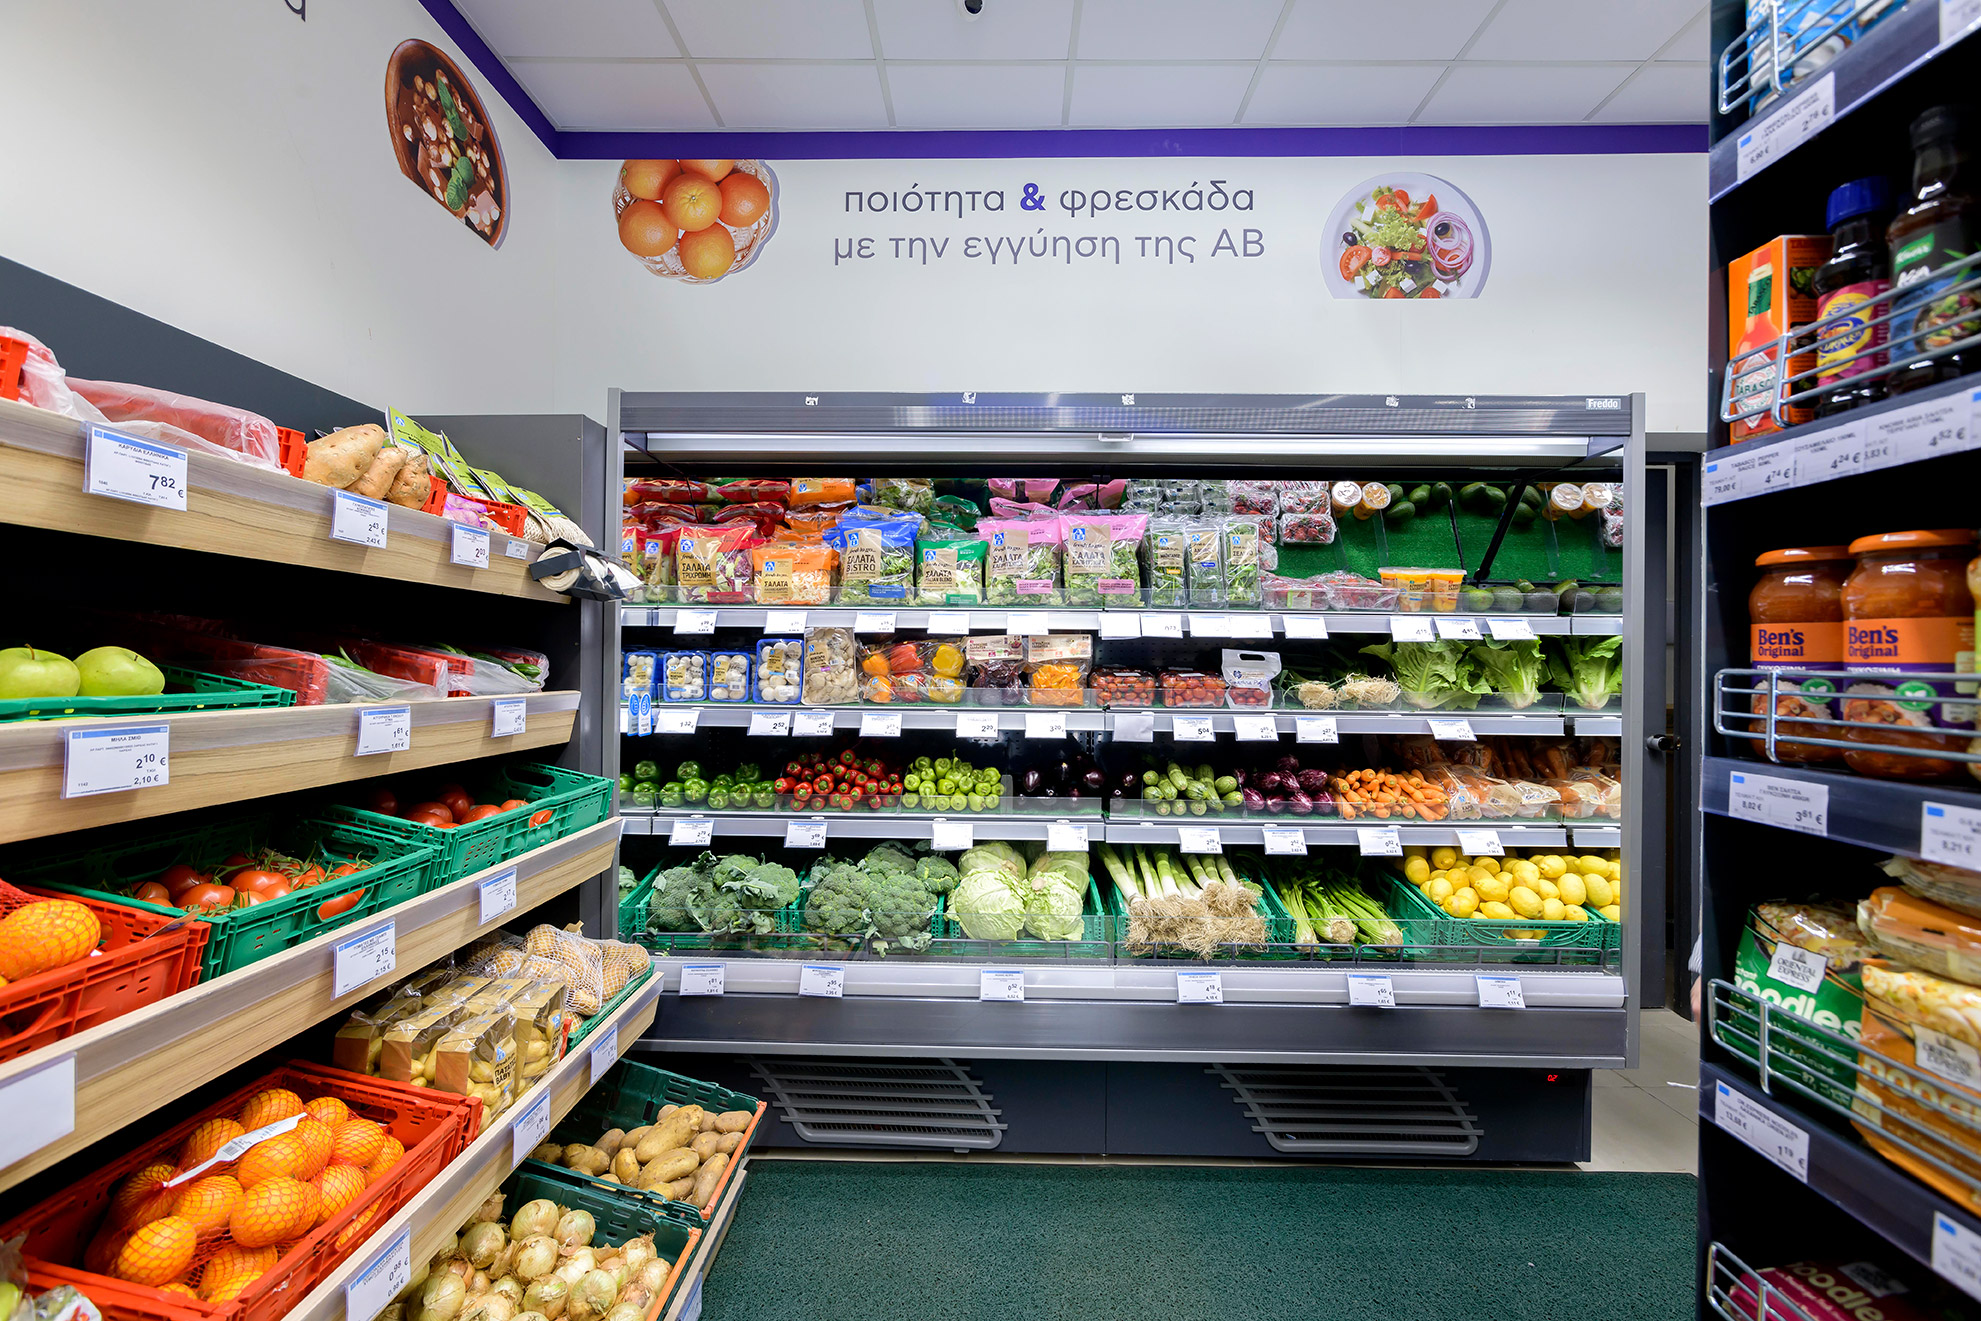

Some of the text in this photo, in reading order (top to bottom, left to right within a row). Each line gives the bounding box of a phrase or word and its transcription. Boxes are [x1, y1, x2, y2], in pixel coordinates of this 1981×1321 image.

[845, 180, 1254, 219] ποιότητα & φρεσκάδα
[834, 227, 1266, 265] με την εγγύηση της ΑΒ
[1588, 398, 1618, 408] Freddo
[1853, 452, 1861, 463] €
[1784, 468, 1791, 479] €
[177, 489, 184, 498] €
[847, 554, 876, 564] ΣΑΛΑΤΑ
[993, 554, 1023, 563] ΣΑΛΑΤΑ
[846, 564, 876, 572] BISTRO
[1758, 629, 1805, 646] Ben's
[1849, 626, 1899, 645] Ben's
[1758, 646, 1804, 659] Original
[1849, 645, 1898, 659] Original
[160, 757, 166, 766] €
[134, 774, 159, 785] 2,10 €
[1815, 814, 1823, 825] €
[1777, 957, 1817, 978] ORIENTAL
[1778, 965, 1810, 983] EXPRESS
